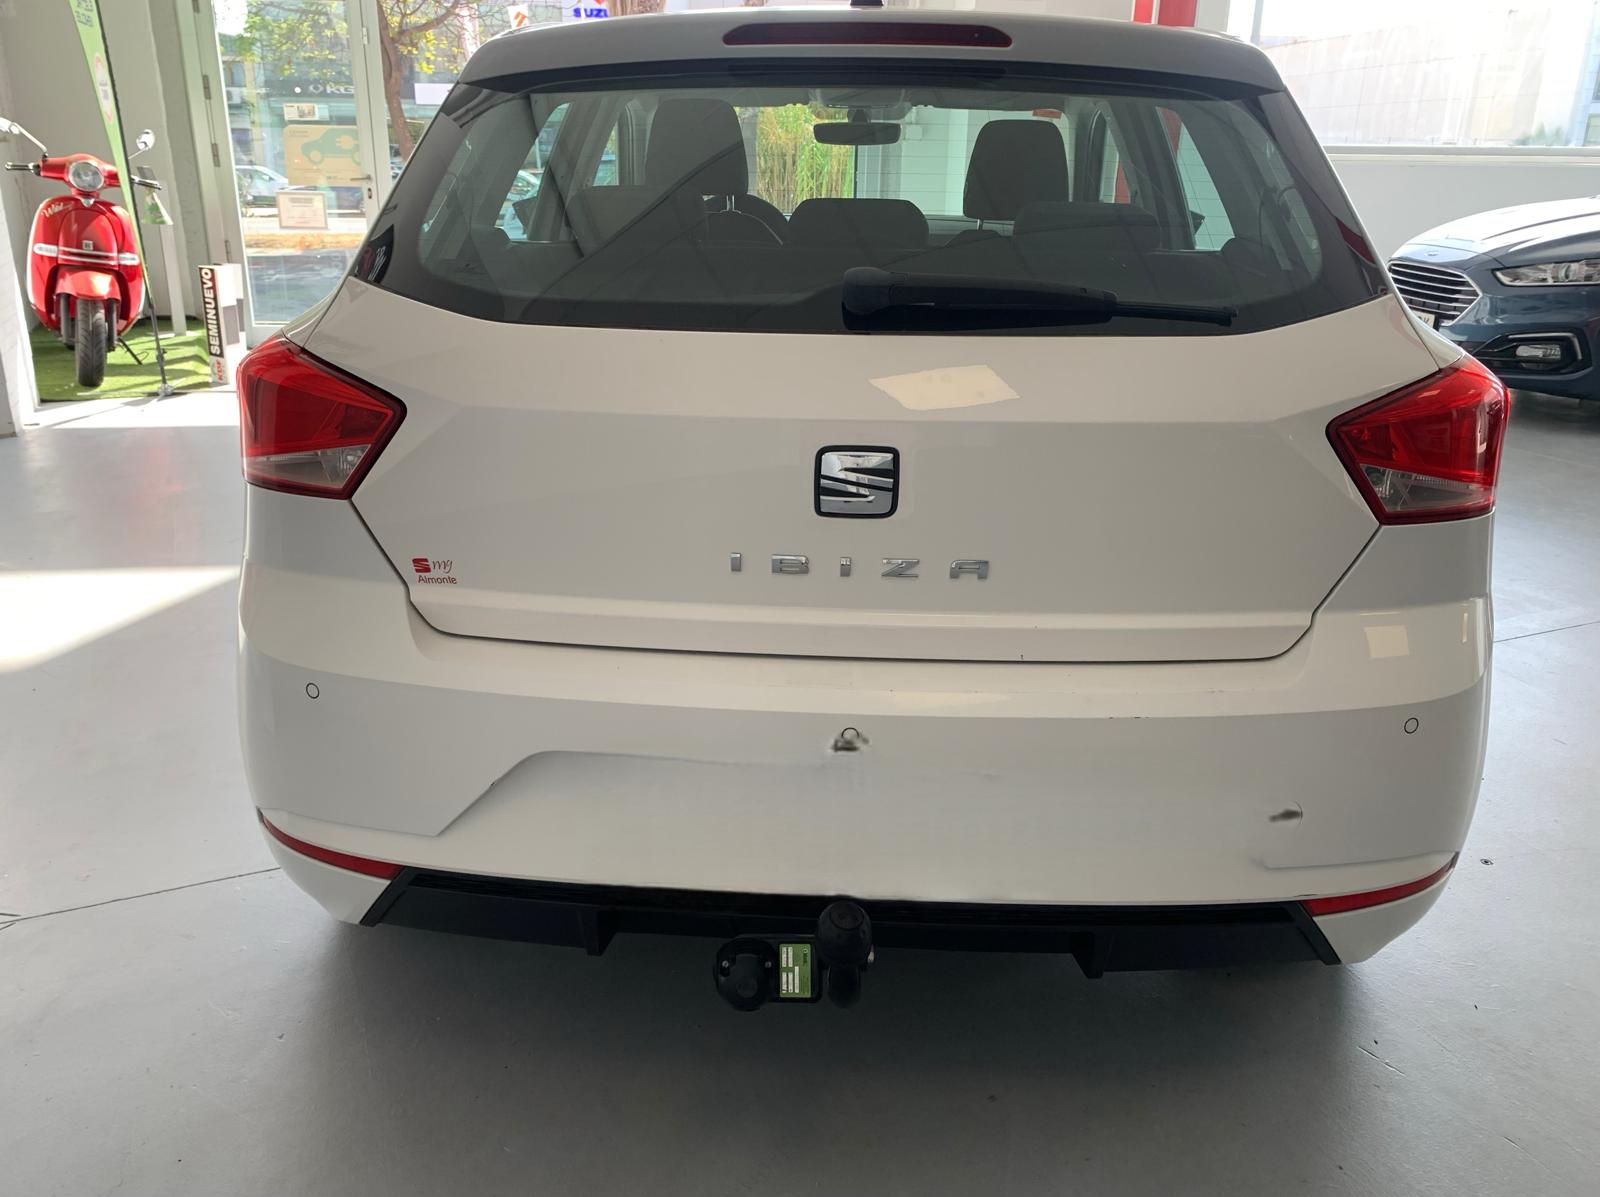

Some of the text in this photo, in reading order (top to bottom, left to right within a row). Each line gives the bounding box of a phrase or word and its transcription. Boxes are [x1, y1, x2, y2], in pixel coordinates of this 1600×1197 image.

[201, 268, 220, 354] SEMINUEVO
[418, 575, 457, 584] Almonte
[730, 552, 989, 580] IBIZA
